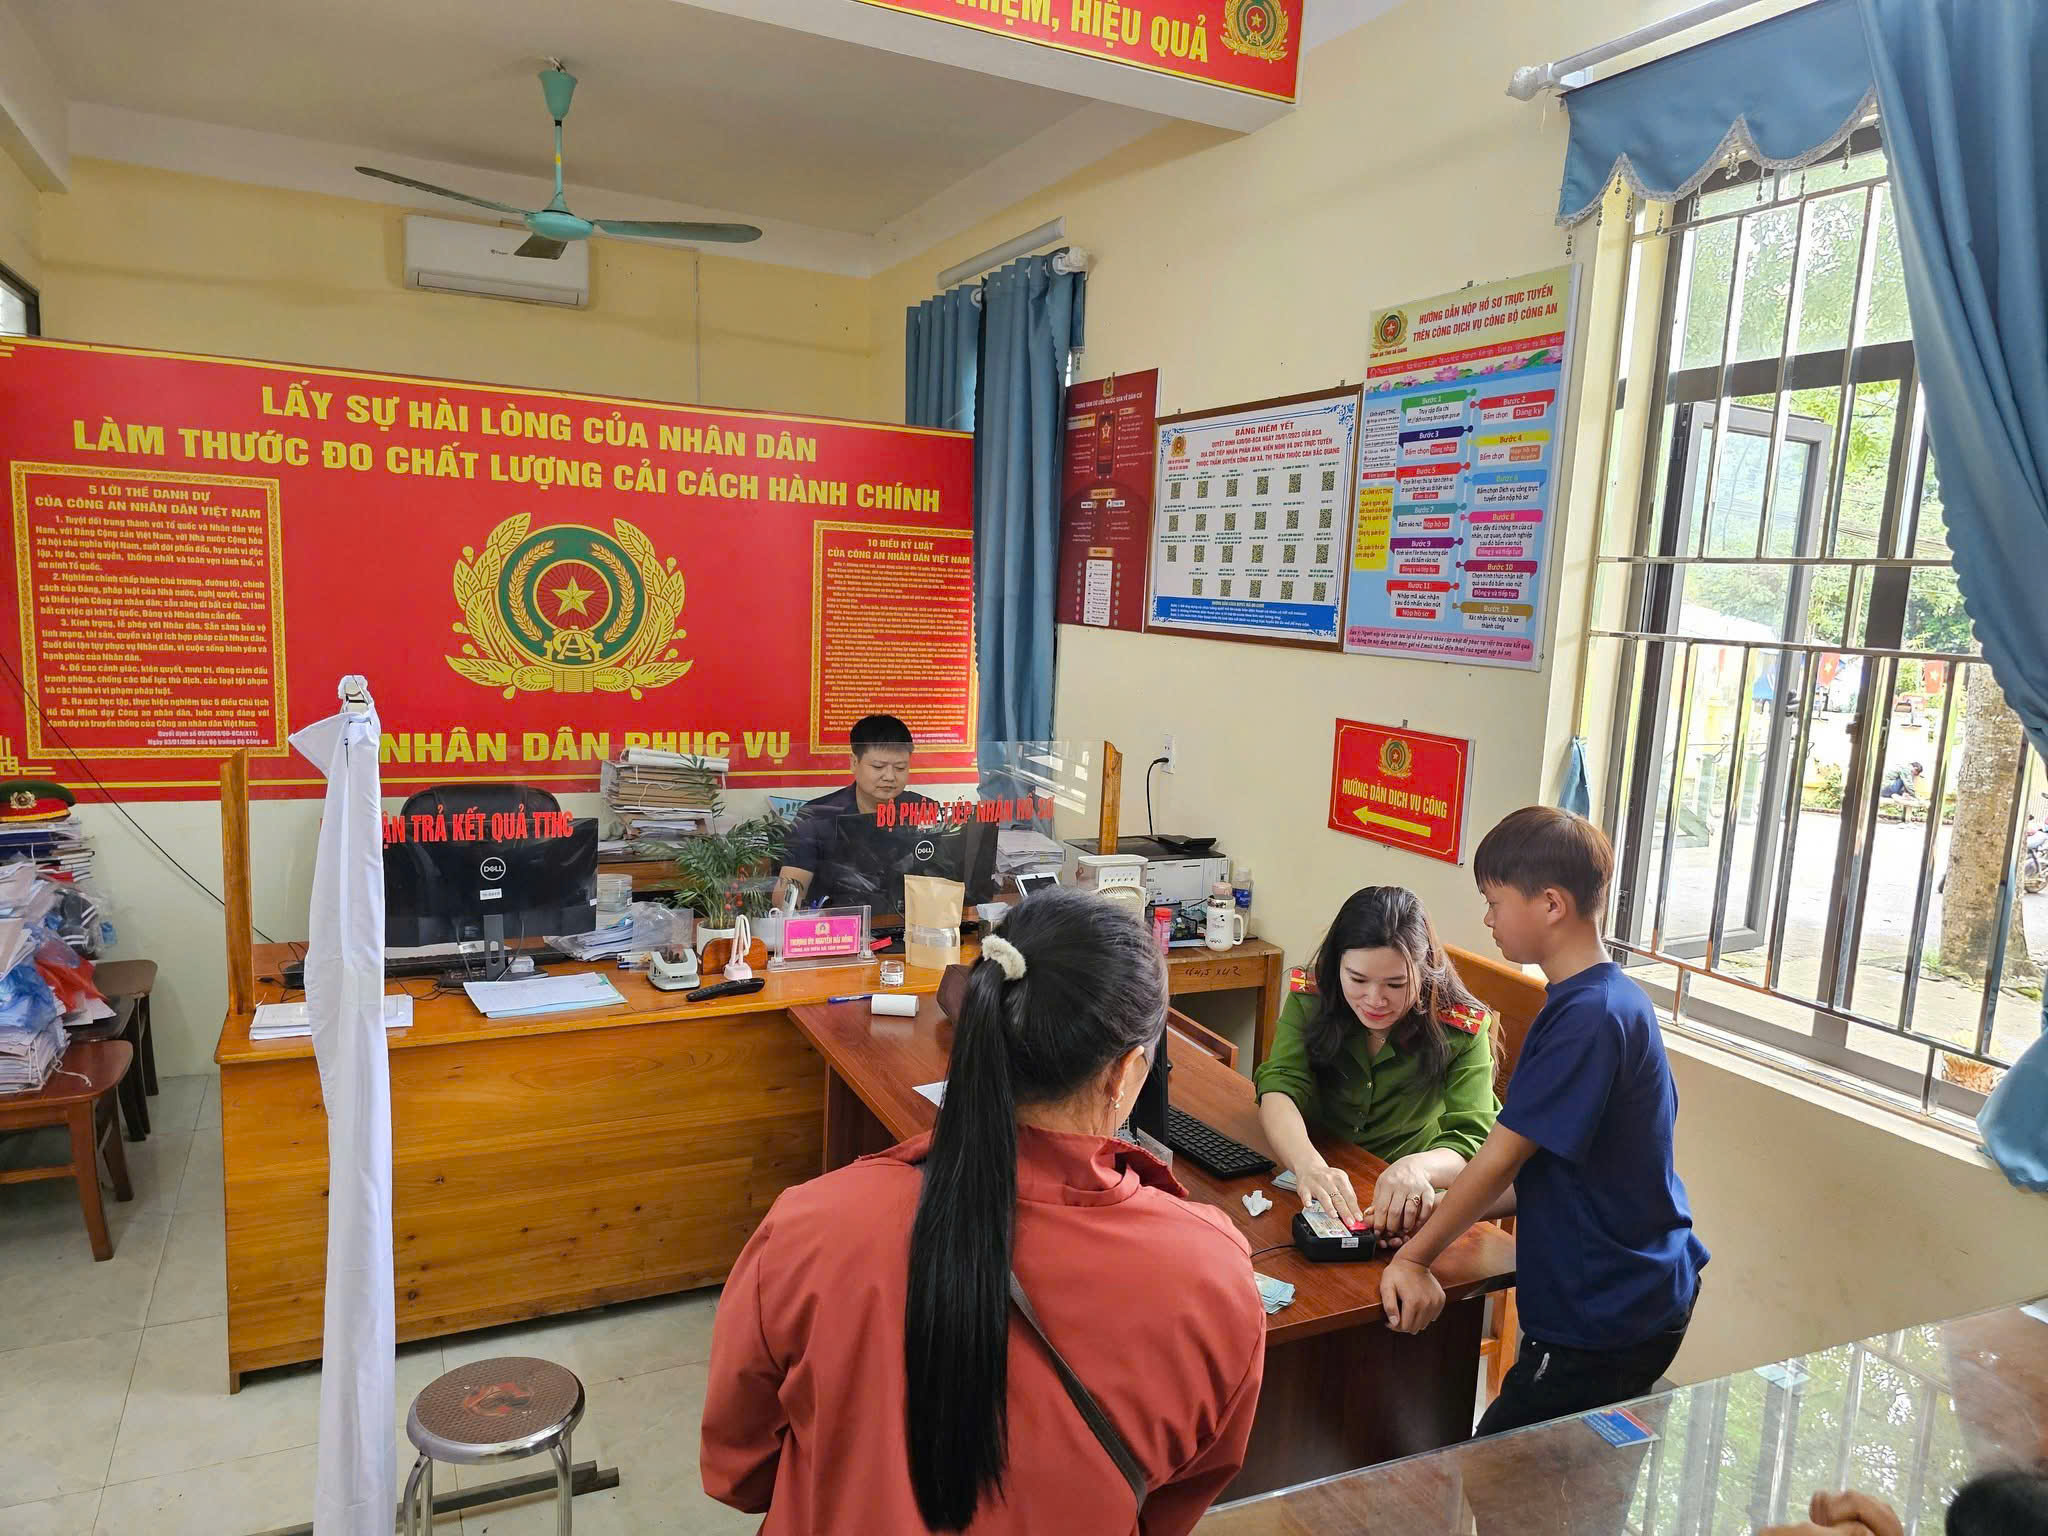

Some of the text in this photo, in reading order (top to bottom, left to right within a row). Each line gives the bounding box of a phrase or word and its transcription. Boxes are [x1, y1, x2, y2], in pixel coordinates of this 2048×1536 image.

[1071, 0, 1140, 47] HIỆU
[1151, 14, 1207, 62] QUẢ
[1453, 321, 1470, 335] DỊCH
[1472, 319, 1482, 331] VỤ
[1507, 311, 1519, 324] BỘ
[1545, 303, 1558, 315] AN
[1461, 303, 1477, 315] NỘP
[1491, 296, 1502, 308] SƠ
[1504, 291, 1524, 306] TRỰC
[262, 381, 816, 461] LẤY SỰ HÀI LÒNG CỦA NHÂN DÂN
[1500, 435, 1516, 443] Bước
[74, 416, 939, 512] LÀM THƯỚC ĐO CHẤT LƯỢNG CẢI CÁCH HÀNH CHÍNH
[35, 495, 260, 518] CỦA CÔNG AN NHÂN DÂN VIỆT NAM
[89, 485, 97, 494] 5
[101, 484, 121, 496] LỜI
[153, 489, 188, 499] DANH
[1414, 505, 1430, 513] Bước
[1492, 513, 1510, 521] Bước
[873, 551, 885, 559] AN
[381, 723, 505, 763] NHÂN
[522, 727, 609, 763] DÂN
[743, 731, 790, 765] VỤ
[876, 799, 896, 832] BỘ
[899, 797, 939, 831] PHẬN
[943, 795, 972, 823] TIẾP
[975, 795, 1013, 827] NHẬN
[1015, 795, 1034, 819] HỒ
[1342, 777, 1368, 798] HƯỚNG
[1388, 788, 1408, 809] DỊCH
[1410, 793, 1421, 815] VỤ
[1422, 796, 1447, 818] CÔNG
[381, 803, 574, 848] ẬN TRẢ KẾT QUẢ TTHC
